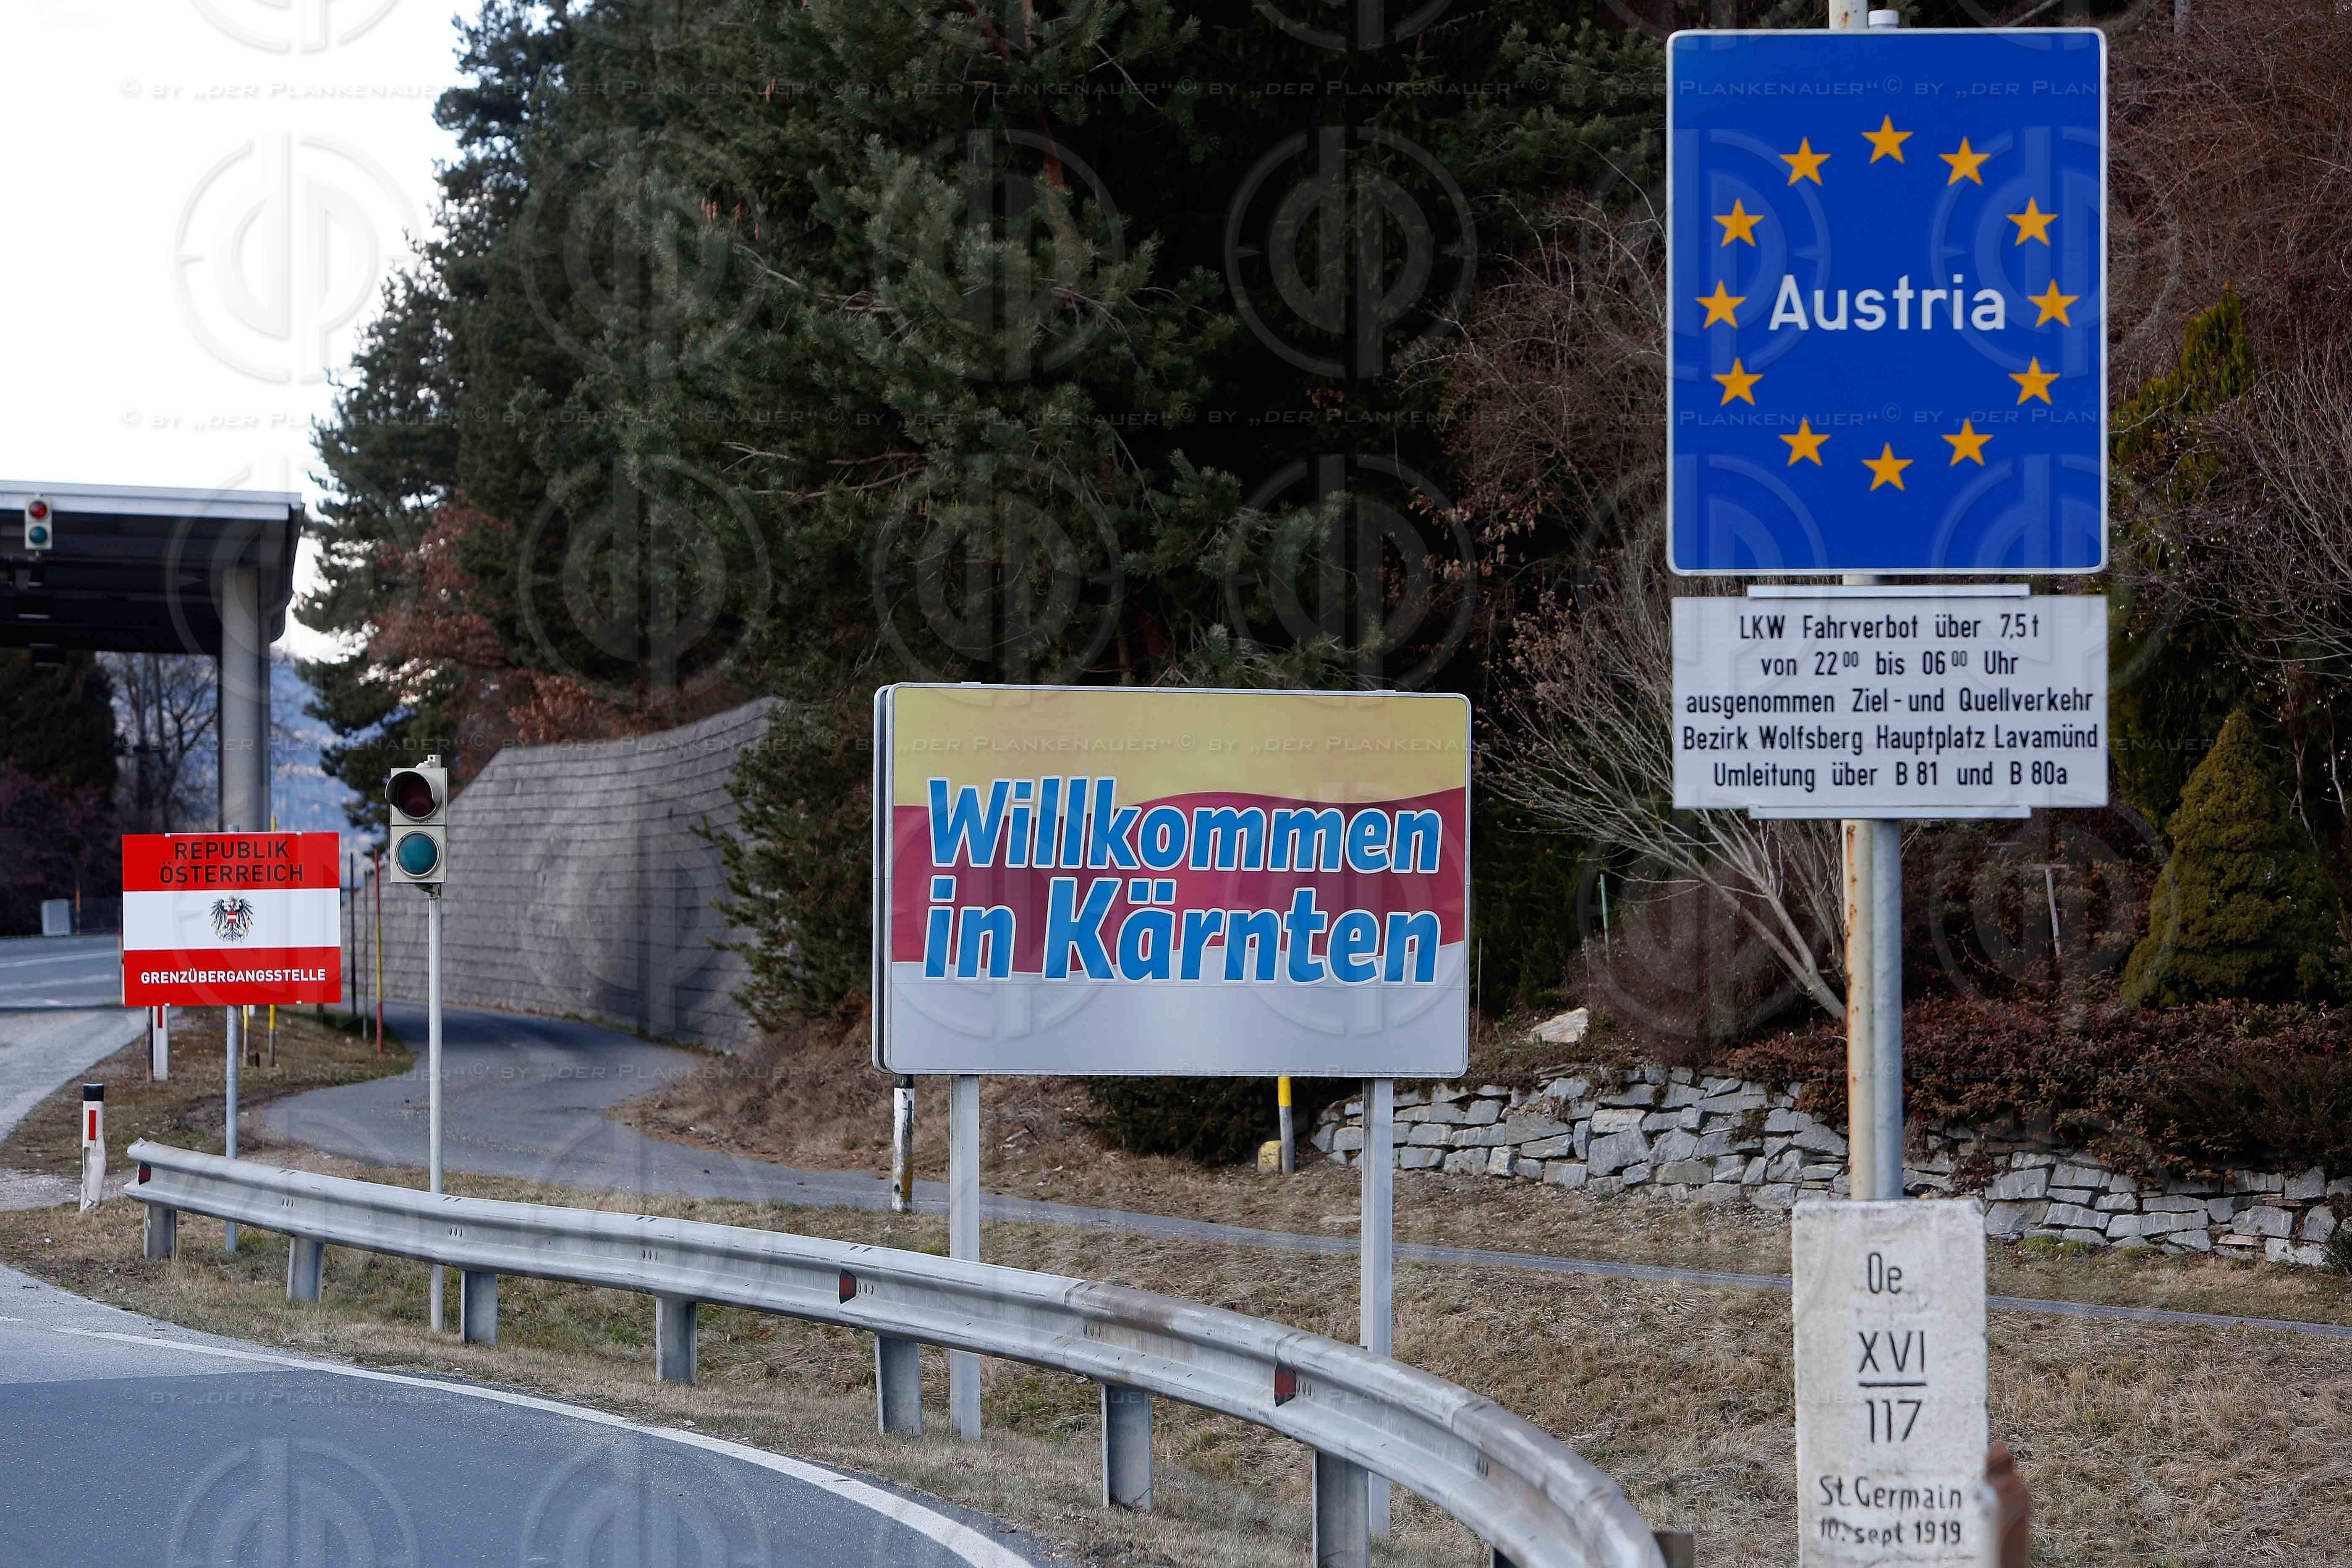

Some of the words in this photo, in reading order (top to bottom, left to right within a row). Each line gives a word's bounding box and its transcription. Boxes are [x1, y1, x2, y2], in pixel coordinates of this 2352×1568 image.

[1769, 274, 2006, 331] Austria
[1740, 615, 1785, 639] LKW
[1803, 614, 1918, 639] Fahrverbot
[1935, 614, 1981, 638] über
[1761, 658, 1797, 675] von
[1876, 651, 1905, 675] bis
[1984, 651, 2018, 674] Uhr
[1687, 695, 1835, 719] ausgenommen
[1909, 687, 1944, 712] und
[1959, 687, 2094, 712] Quellverkehr
[1683, 725, 1748, 749] Bezirk
[1758, 725, 1862, 755] Wolfsberg
[1876, 724, 1985, 755] Hauptplatz
[1994, 724, 2098, 749] Lavamünd
[1714, 762, 1815, 793] Umleitung
[1832, 762, 1878, 786] über
[1896, 762, 1907, 785] B
[1917, 761, 1938, 785] 81
[1957, 761, 1993, 785] und
[2010, 761, 2022, 785] B
[2031, 761, 2067, 785] 80a
[927, 775, 1443, 874] Willkommen
[175, 840, 290, 860] REPUBLIK
[160, 861, 303, 883] ÖSTERREICH
[922, 875, 1017, 981] in
[1041, 876, 1442, 986] Kärnten
[141, 968, 326, 984] GRENZÜBERGANGSSTELLE
[1858, 1331, 1926, 1373] XVI
[1866, 1399, 1923, 1443] 117
[1854, 1521, 1903, 1548] sept
[1915, 1520, 1961, 1545] 1919
